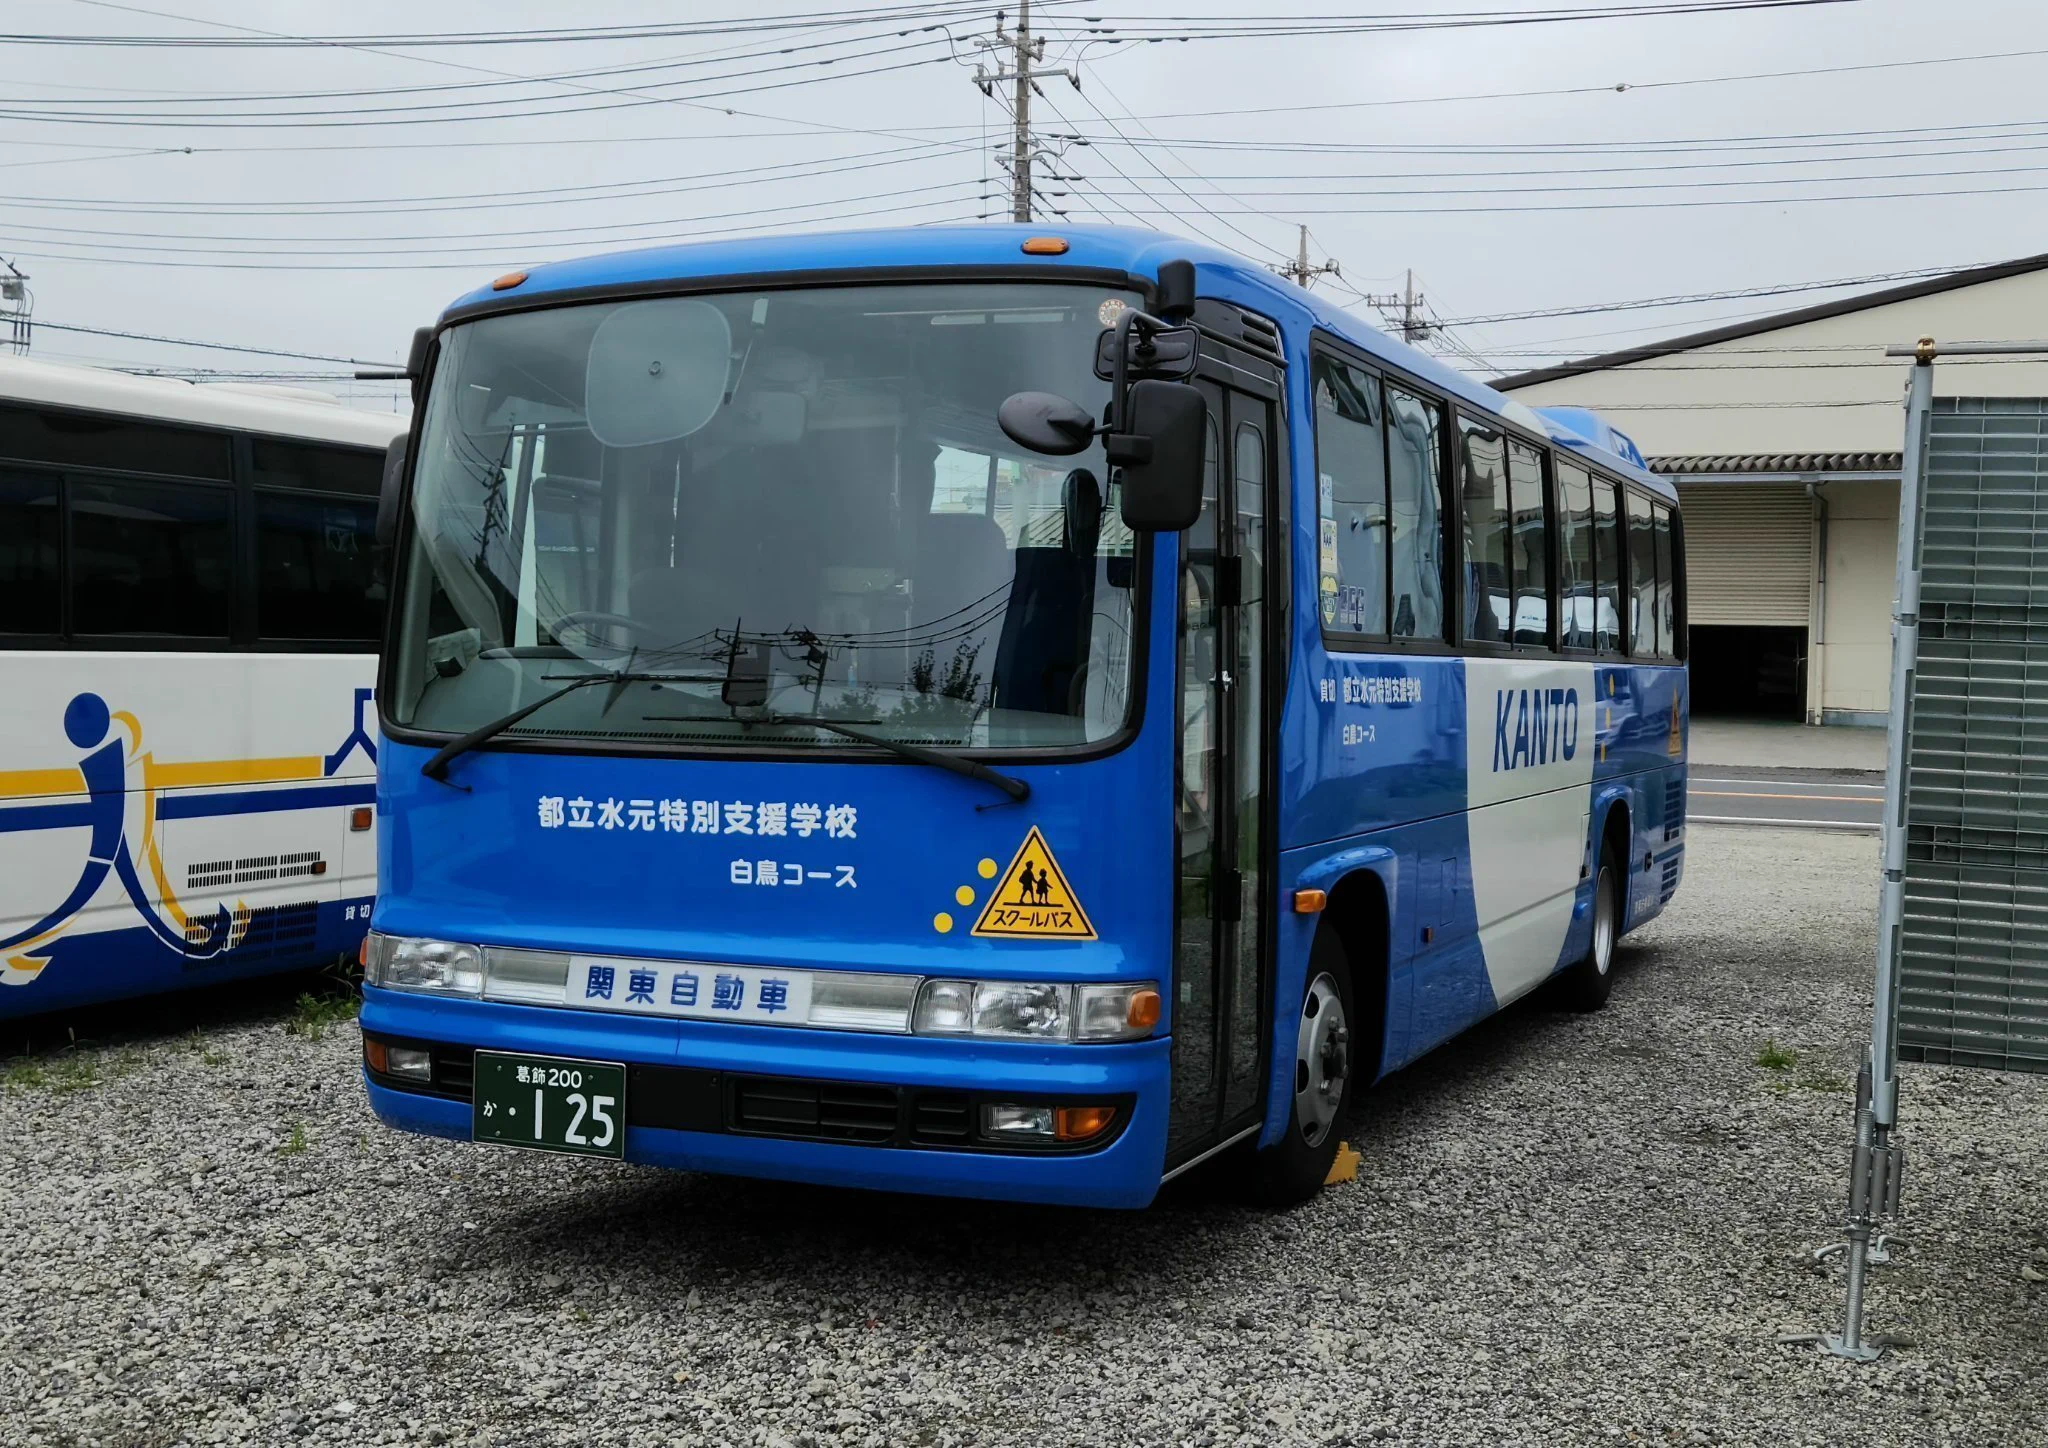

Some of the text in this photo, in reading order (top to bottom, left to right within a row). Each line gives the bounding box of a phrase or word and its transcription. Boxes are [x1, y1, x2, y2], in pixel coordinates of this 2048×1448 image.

[1493, 687, 1578, 773] KANTO
[538, 795, 858, 839] 都立水元特別支援学校
[730, 858, 857, 889] 白鳥コース
[345, 904, 371, 921] 貸切
[993, 909, 1073, 928] スクールバス
[586, 965, 791, 1015] 関東自動車
